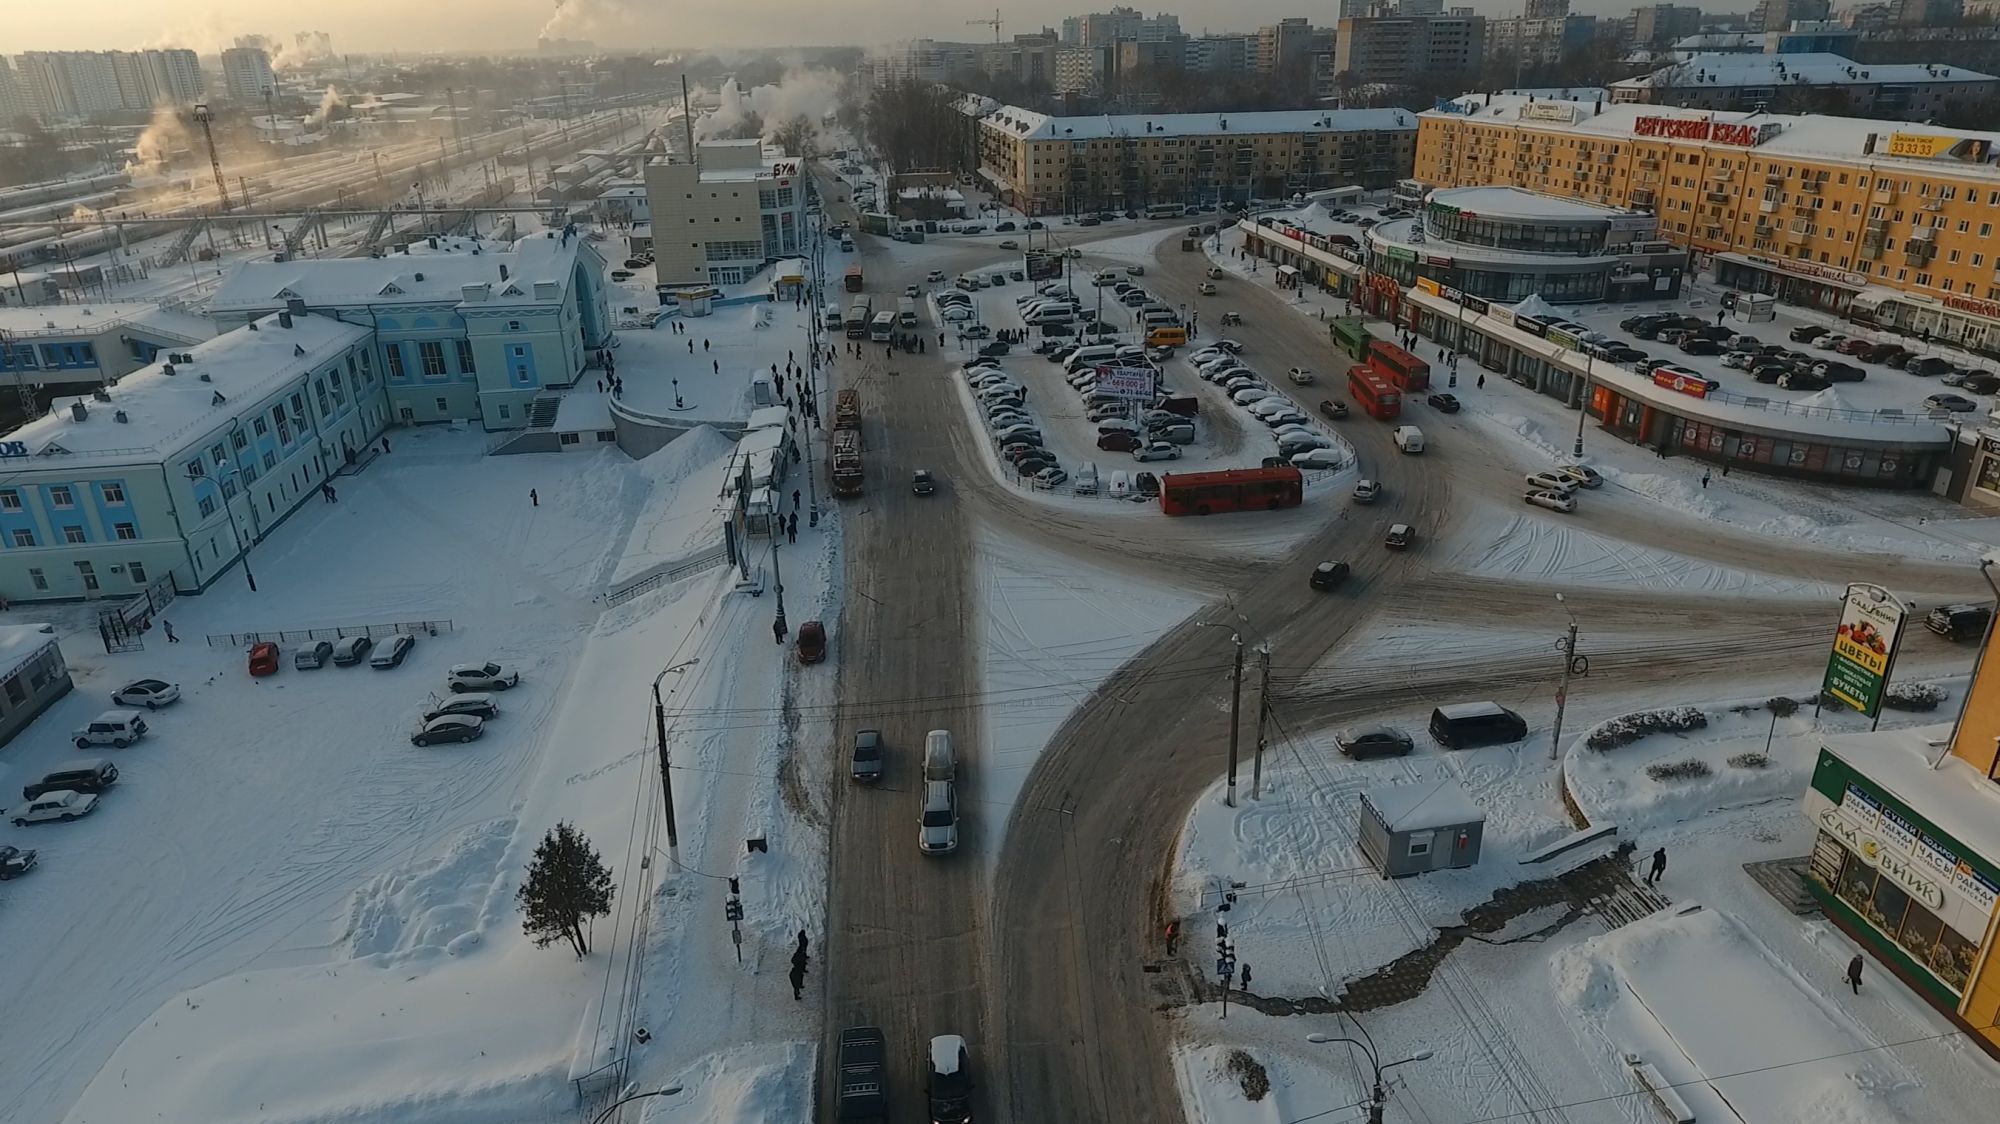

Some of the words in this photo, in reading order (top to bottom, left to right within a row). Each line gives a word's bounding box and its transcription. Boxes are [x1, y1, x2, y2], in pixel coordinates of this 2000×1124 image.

[1634, 116, 1710, 140] ВЯТСКИЙ
[1711, 123, 1757, 147] КВАС
[1892, 142, 1904, 152] 33
[1905, 143, 1918, 154] 33
[1919, 144, 1932, 155] 33
[774, 163, 797, 178] БУМ
[1815, 266, 1845, 282] АПТЕКА
[1942, 294, 1998, 317] АПТЕКА
[1840, 640, 1882, 671] ЦВЕТЫ
[1832, 677, 1869, 703] БУКЕТЫ
[1845, 794, 1877, 820] ОДЕЖДА
[1880, 818, 1913, 846] ОДЕЖДА
[1884, 809, 1917, 835] СУМКИ
[1919, 845, 1953, 875] ЧАСЫ
[1922, 835, 1957, 863] ПОДАРОК
[1956, 872, 1994, 903] ОДЕЖДА
